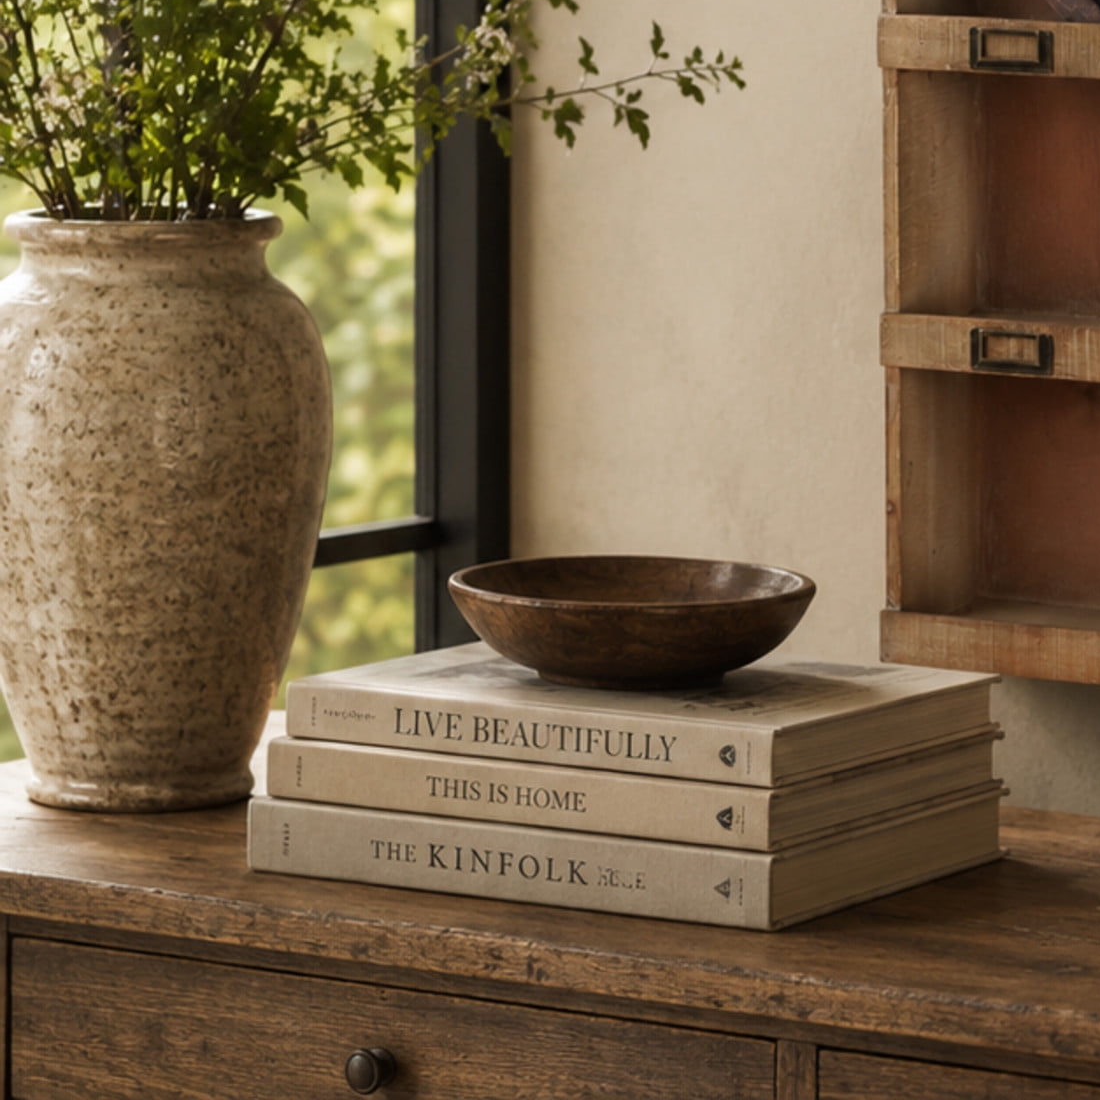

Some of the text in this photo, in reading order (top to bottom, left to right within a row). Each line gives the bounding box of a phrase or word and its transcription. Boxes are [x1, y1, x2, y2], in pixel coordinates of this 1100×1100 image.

[393, 707, 677, 762] LIVE BEAUTIFULLY
[426, 775, 587, 813] THIS IS HOME
[370, 839, 417, 863] THE
[427, 843, 588, 886] KINFOLK
